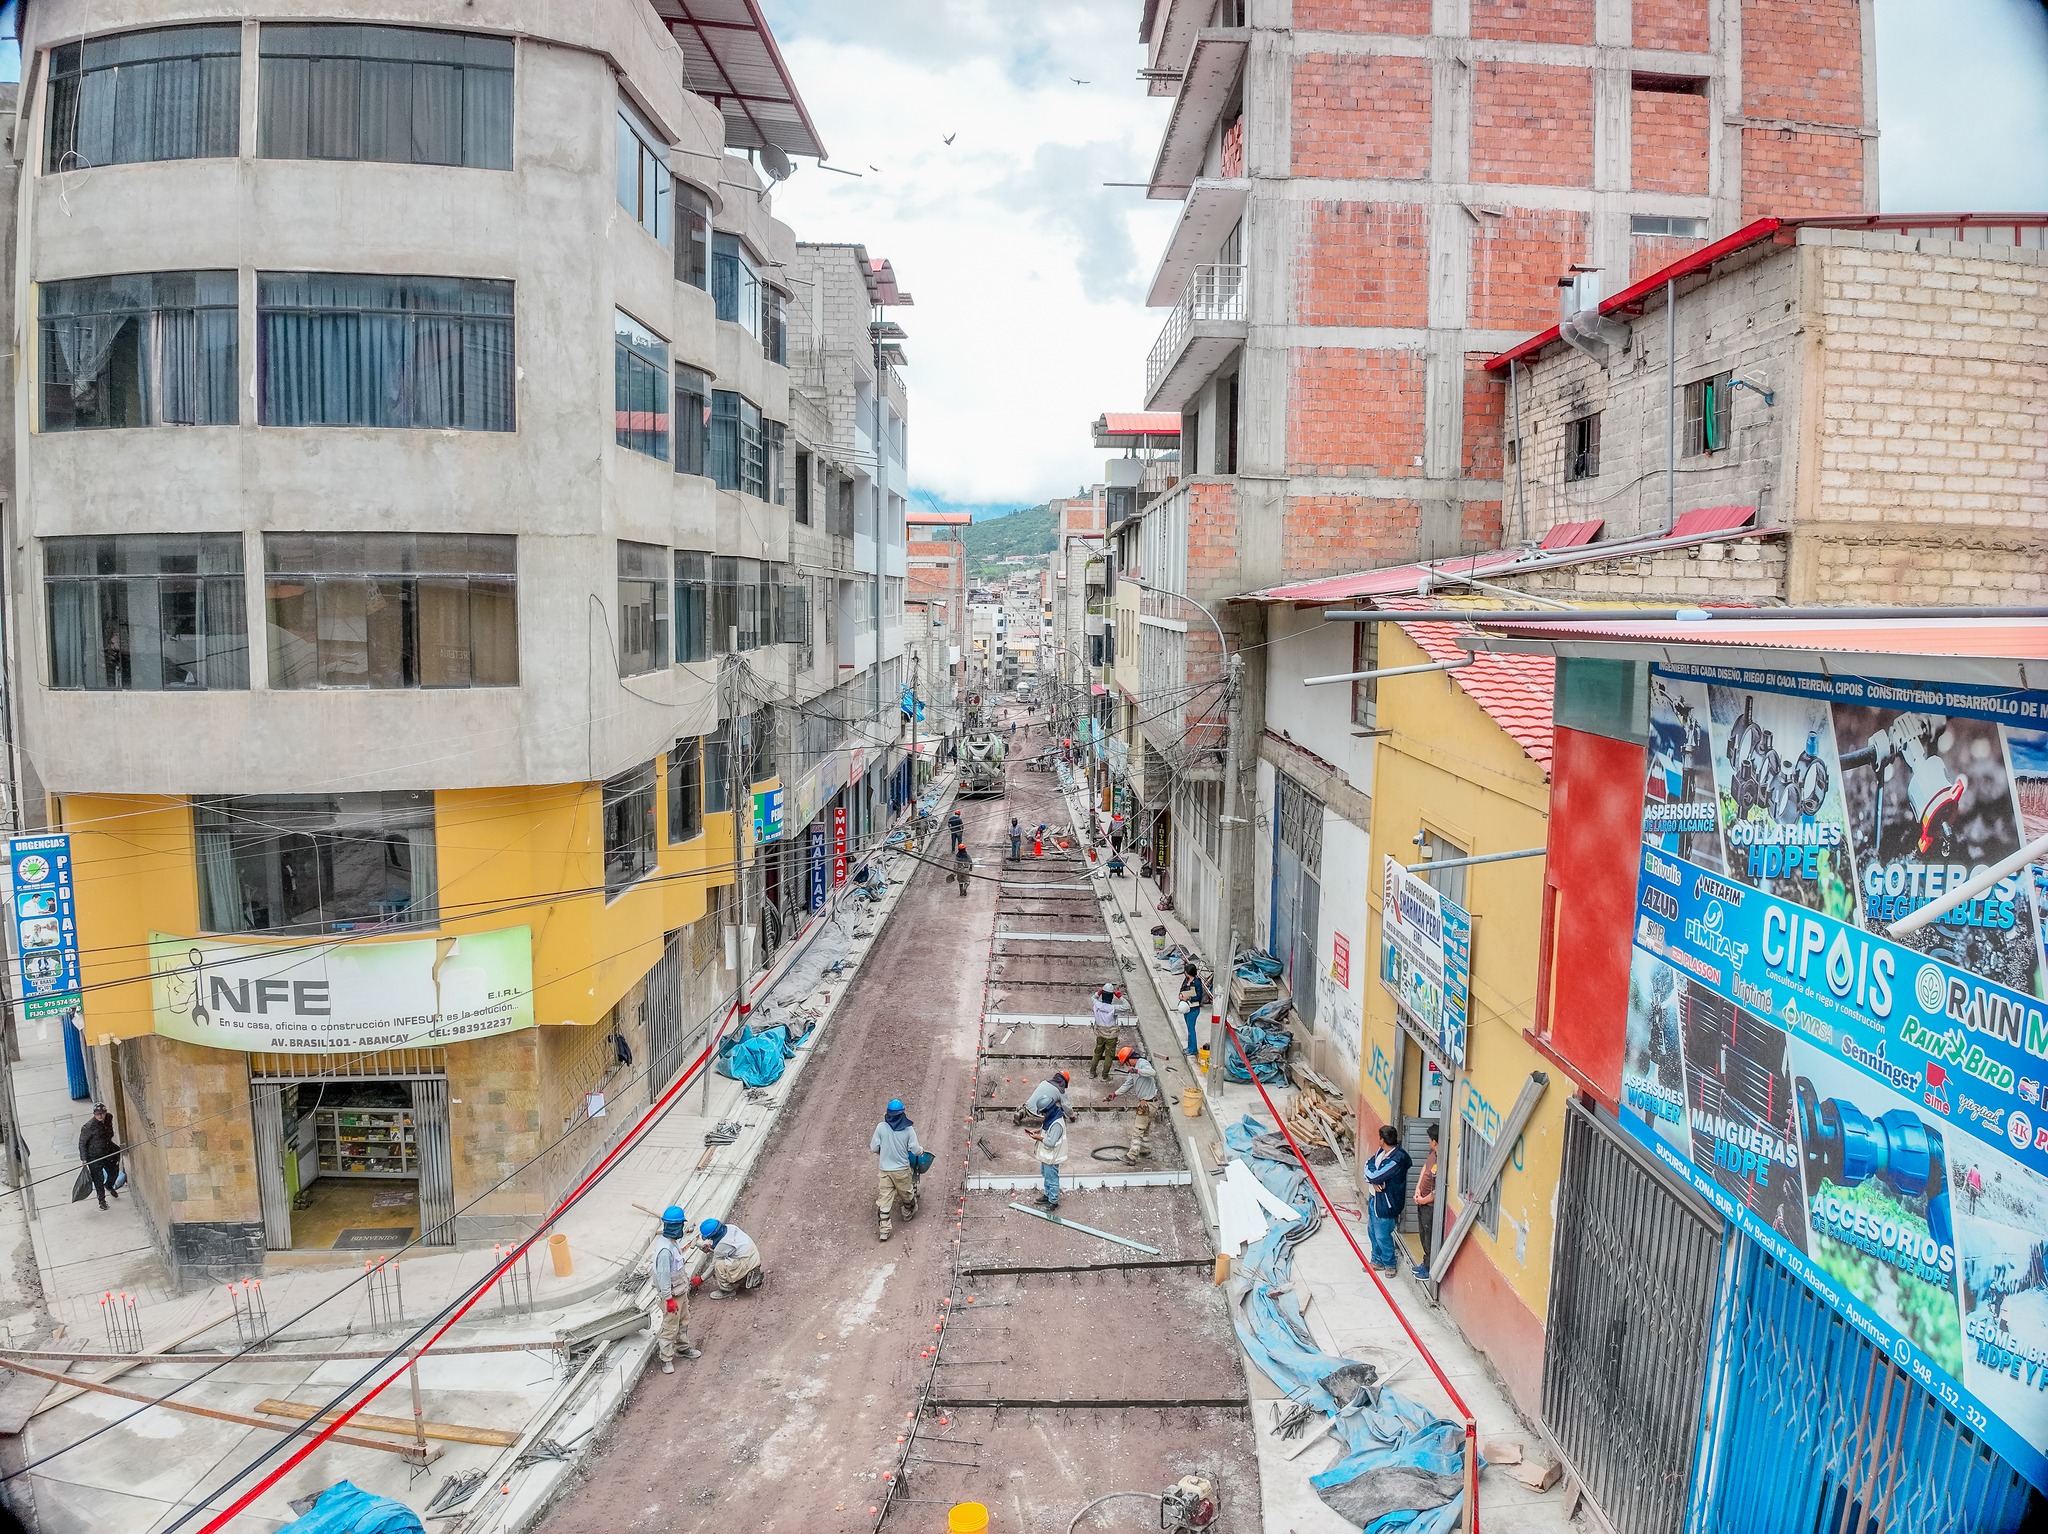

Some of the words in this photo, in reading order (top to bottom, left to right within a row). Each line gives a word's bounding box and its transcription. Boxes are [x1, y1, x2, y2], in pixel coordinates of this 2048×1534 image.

[1691, 665, 1700, 676] EN
[1700, 667, 1716, 678] CADA
[1743, 671, 1765, 684] RIEGO
[1766, 673, 1776, 685] EN
[1776, 675, 1796, 689] CADA
[1797, 678, 1834, 694] TERRENO,
[1835, 682, 1863, 697] CIPOIS
[1867, 685, 1944, 706] CONSTRUYENDO
[1946, 693, 2019, 714] DESARROLLO
[2020, 702, 2038, 717] DE
[1645, 802, 1715, 820] ASPERSORES
[1655, 819, 1677, 832] LARGO
[1677, 819, 1714, 832] ALCANCE
[15, 838, 66, 852] URGENCIAS
[1157, 823, 1165, 867] INTERNET
[1731, 821, 1841, 846] COLLARINES
[812, 834, 824, 908] MALLAS
[1652, 856, 1682, 886] Rivulis
[1748, 845, 1819, 880] HDPE
[1404, 879, 1436, 912] CORPORACIÓN
[1643, 885, 1679, 921] AZUD
[1702, 878, 1742, 907] NETAFIM
[1426, 910, 1441, 942] PERÚ
[1684, 952, 1721, 986] PLASSON
[29, 1002, 43, 1010] CEL.
[487, 987, 523, 1000] E.I.R.L.
[1765, 966, 1804, 993] Consultoría
[1805, 985, 1815, 998] de
[1815, 991, 1834, 1009] riego
[1834, 999, 1840, 1012] y
[1840, 1002, 1887, 1035] construcción
[219, 1016, 231, 1027] En
[233, 1020, 244, 1028] su
[247, 1021, 273, 1031] casa,
[275, 1021, 307, 1031] oficina
[320, 1018, 390, 1032] construcción
[446, 1012, 459, 1021] es
[461, 1009, 471, 1019] la
[271, 1037, 288, 1047] AV.
[290, 1038, 327, 1048] BRASIL
[329, 1038, 351, 1047] 101
[358, 1033, 409, 1046] ABANCAY
[428, 1028, 451, 1039] CEL:
[452, 1016, 513, 1036] 983912237
[1800, 1010, 1834, 1045] VYRSA
[1842, 1035, 1919, 1092] Senninger
[1902, 1016, 1948, 1058] RAIN
[1964, 1048, 2014, 1091] BIRD
[1624, 1073, 1684, 1106] ASPERSORES
[1627, 1087, 1681, 1125] WOBBLER
[1924, 1092, 1950, 1115] sime
[1692, 1107, 1798, 1168] MANGUERAS
[1713, 1139, 1771, 1187] HDPE
[1812, 1192, 1955, 1273] ACCESORIOS
[1811, 1215, 1827, 1233] DE
[1899, 1254, 1914, 1273] DE
[1914, 1262, 1950, 1291] HDPE
[1656, 1142, 1692, 1182] SUCURSAL
[1693, 1174, 1715, 1201] ZONA
[1715, 1192, 1734, 1218] SUR:
[1743, 1217, 1754, 1233] Av
[1754, 1225, 1776, 1252] Brasil
[1787, 1253, 1803, 1275] 102
[1803, 1267, 1840, 1308] Abancay
[1845, 1302, 1890, 1350] Apurímac
[1912, 1359, 1932, 1383] 948
[1938, 1382, 1959, 1408] 152
[1965, 1408, 1988, 1433] 322
[1966, 1318, 2048, 1371] GEOMEMBR
[1976, 1339, 2022, 1380] HDPE
[2026, 1360, 2038, 1386] Y
